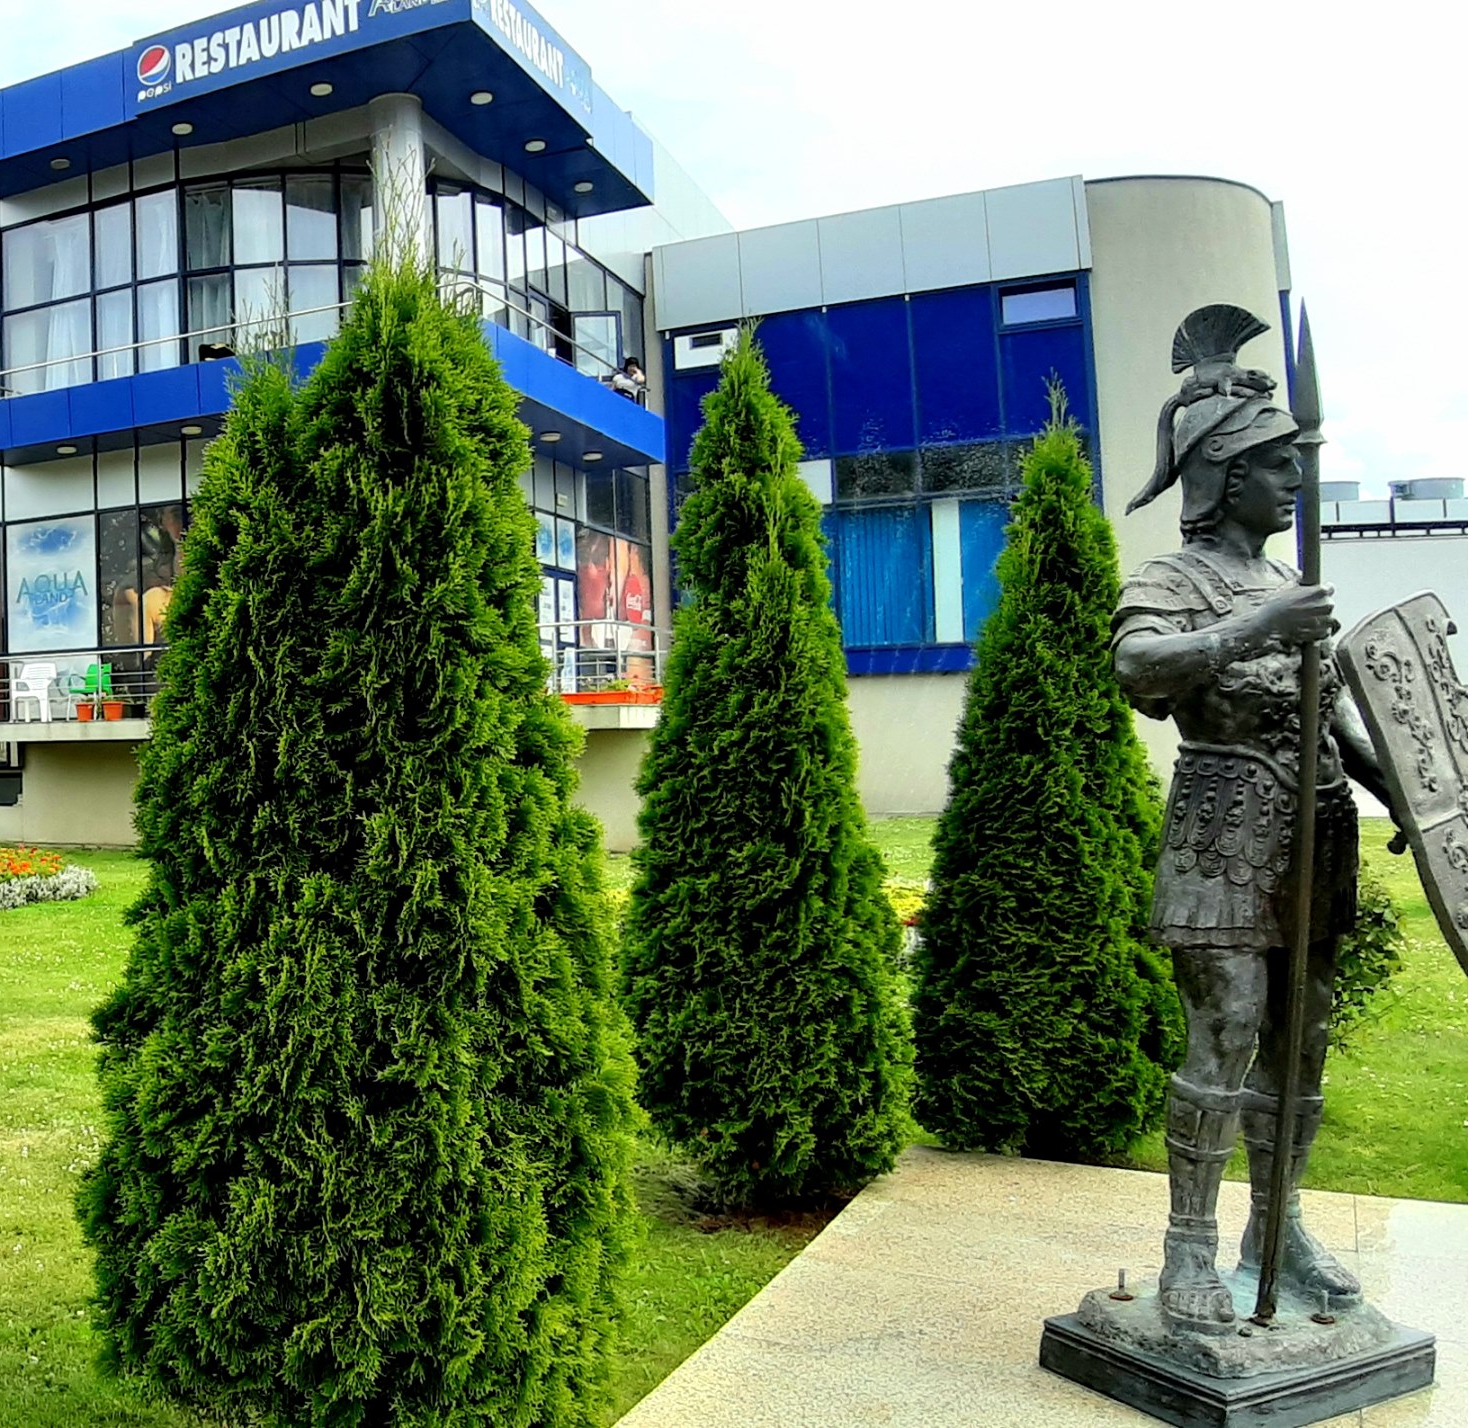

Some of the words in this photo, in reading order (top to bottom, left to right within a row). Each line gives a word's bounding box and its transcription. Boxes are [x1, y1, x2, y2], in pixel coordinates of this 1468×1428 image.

[175, 0, 360, 84] RESTAURANT
[490, 0, 564, 89] RESTAURANT
[137, 80, 172, 102] pepsi
[16, 570, 88, 604] AQUA
